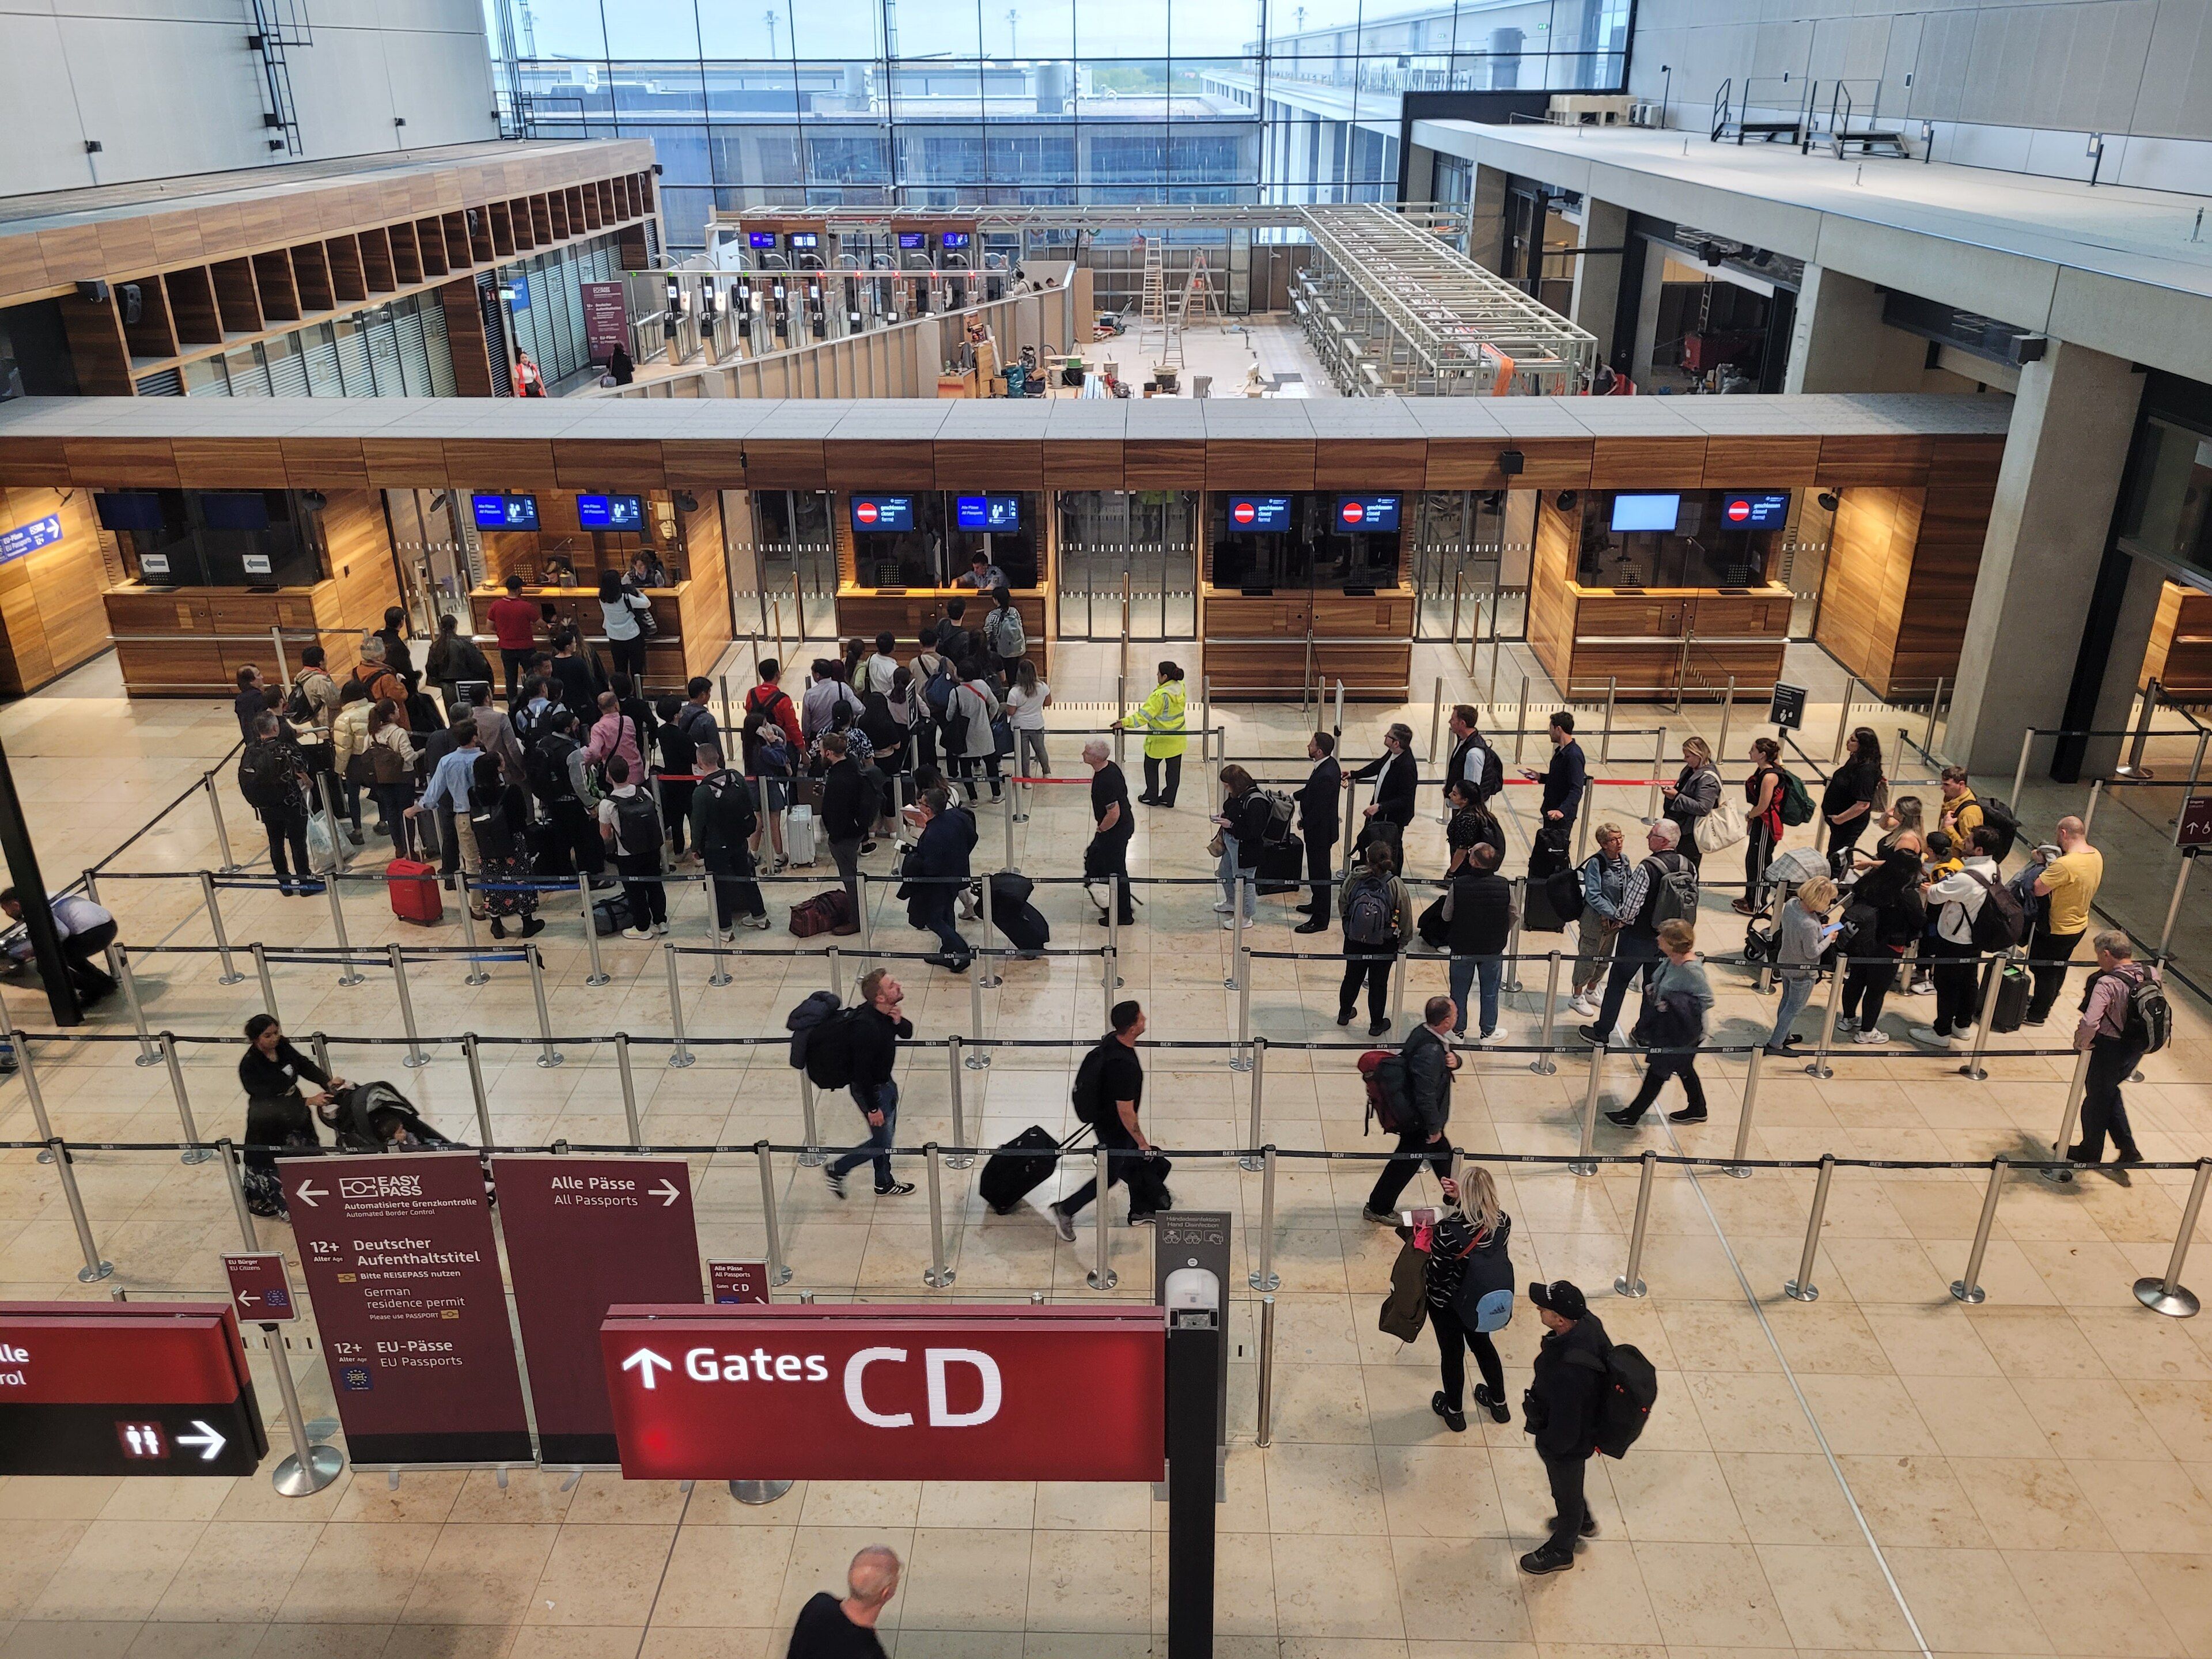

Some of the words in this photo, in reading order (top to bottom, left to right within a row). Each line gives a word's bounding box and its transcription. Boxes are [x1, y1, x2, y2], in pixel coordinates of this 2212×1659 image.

[377, 1175, 421, 1187] EASY
[551, 1176, 584, 1190] Alle
[589, 1177, 635, 1191] Pässe
[380, 1185, 423, 1197] PASS
[344, 1200, 410, 1210] Automatisierte
[412, 1198, 478, 1208] Grenzkontrolle
[554, 1194, 572, 1205] All
[575, 1195, 638, 1209] Passports
[346, 1210, 384, 1218] Automated
[309, 1241, 340, 1253] 12+
[353, 1237, 431, 1251] Deutscher
[357, 1251, 481, 1267] Aufenthaltstitel
[384, 1271, 429, 1279] REISEPASS
[364, 1287, 411, 1297] German
[367, 1298, 422, 1309] residence
[426, 1297, 466, 1309] permit
[334, 1342, 363, 1354] 12+
[377, 1340, 453, 1353] EU-Pässe
[380, 1357, 397, 1368] EU
[402, 1357, 463, 1368] Passports
[685, 1346, 828, 1381] Gates
